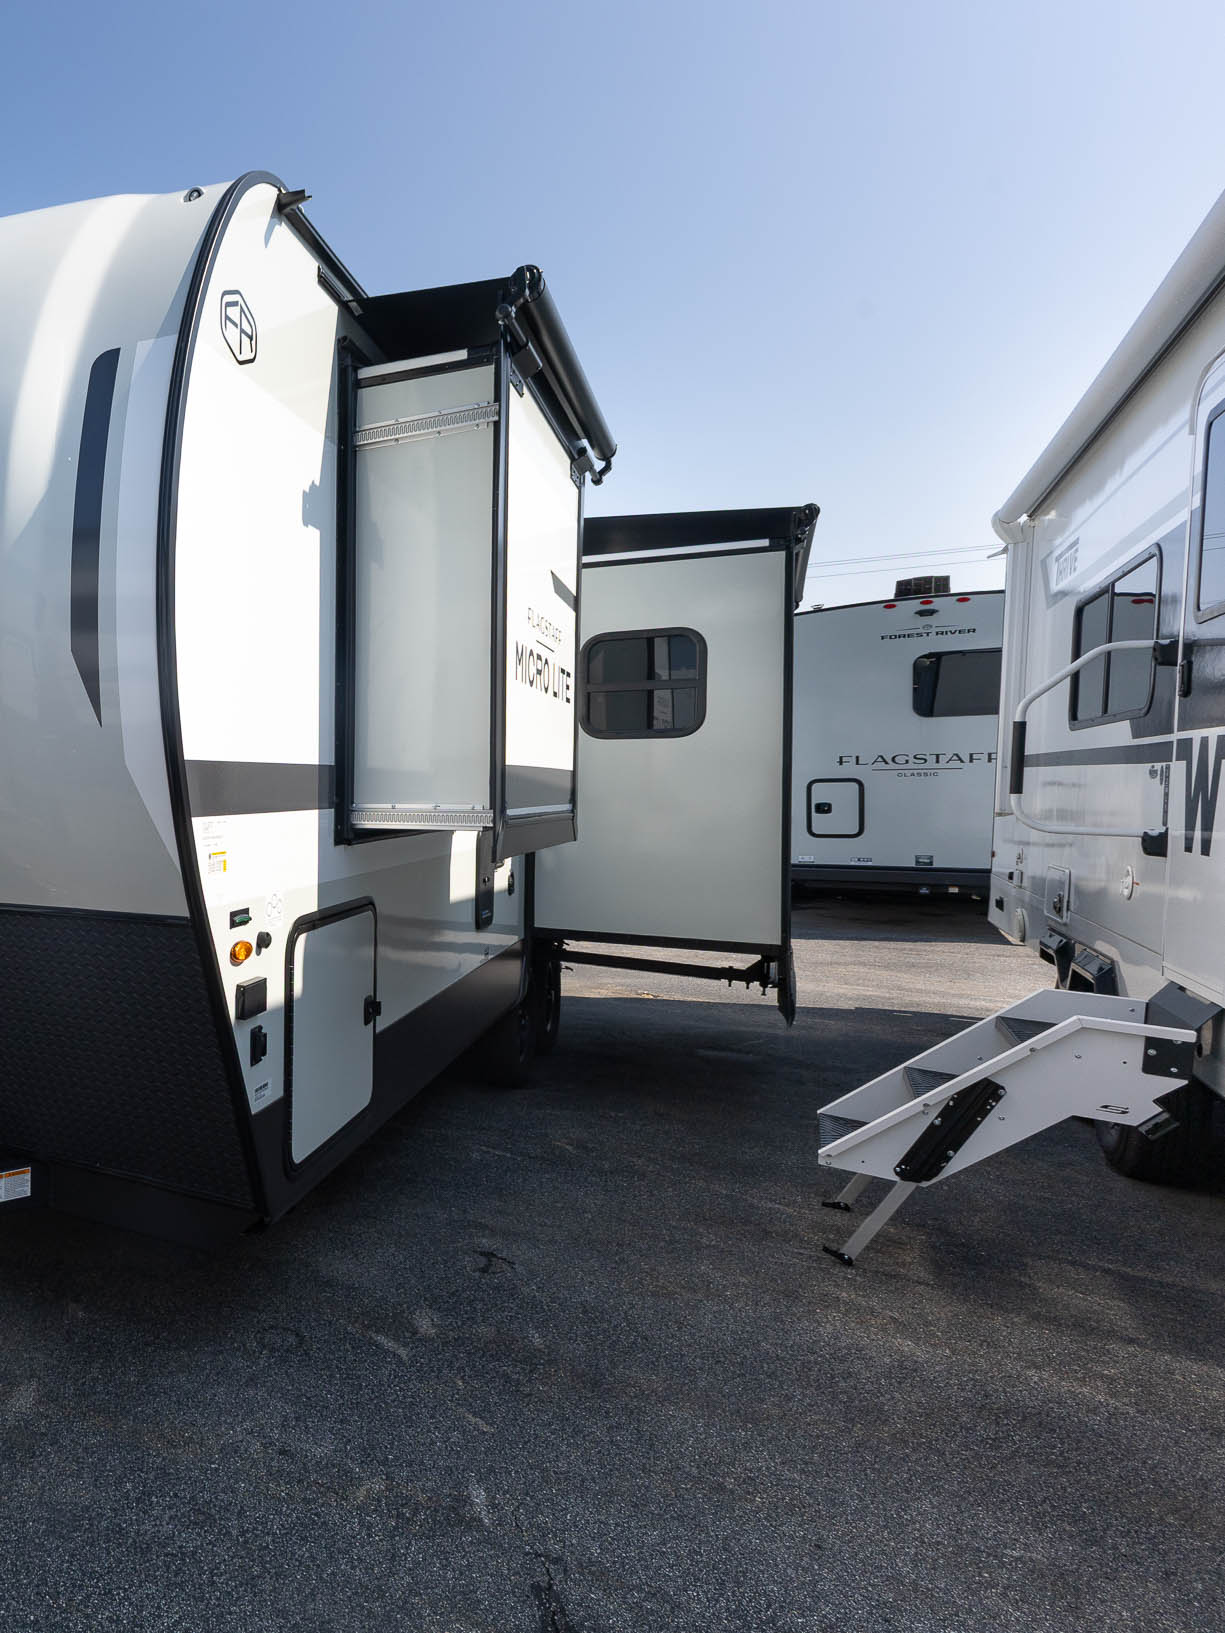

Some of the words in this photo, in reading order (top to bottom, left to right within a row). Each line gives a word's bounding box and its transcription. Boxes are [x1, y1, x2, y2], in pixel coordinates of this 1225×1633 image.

[880, 631, 933, 641] FOREST
[935, 627, 977, 637] RIVER
[515, 639, 550, 695] MICRO
[553, 662, 571, 704] LITE
